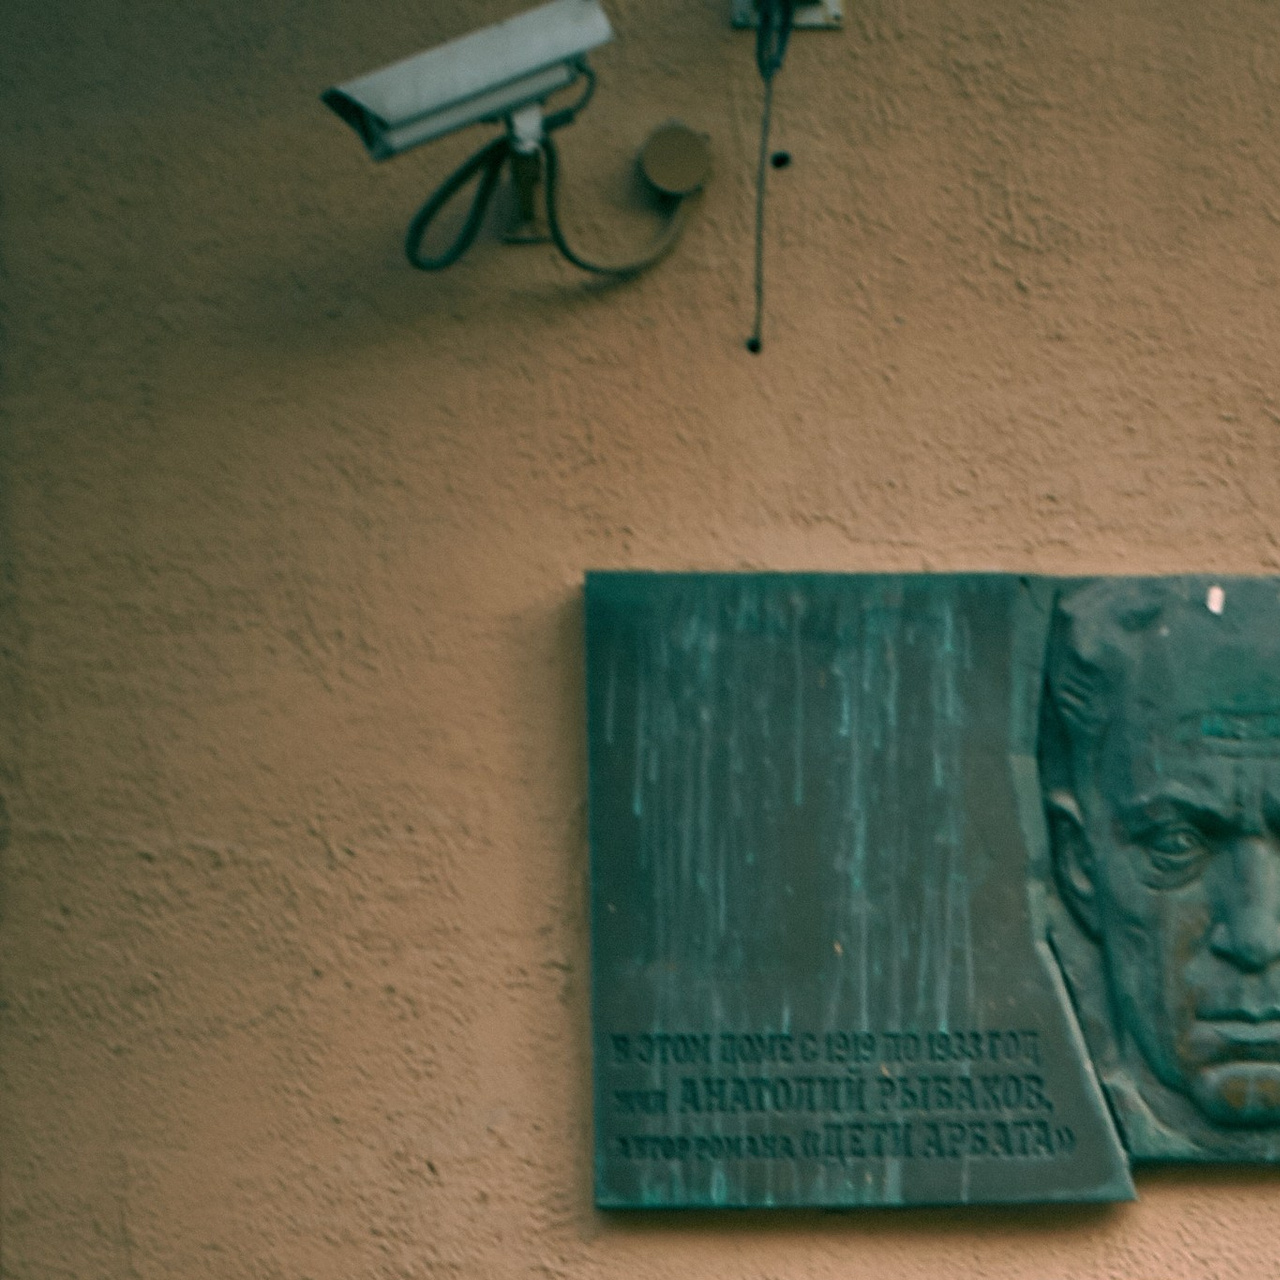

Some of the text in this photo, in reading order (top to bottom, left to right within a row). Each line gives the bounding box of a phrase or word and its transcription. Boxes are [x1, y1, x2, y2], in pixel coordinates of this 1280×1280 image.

[637, 1033, 712, 1063] ЭТОМ
[719, 1033, 794, 1064] ДОМЕ
[824, 1031, 876, 1063] 1919
[883, 1031, 921, 1062] ПО
[680, 1067, 867, 1113] АНАТОЛИЙ
